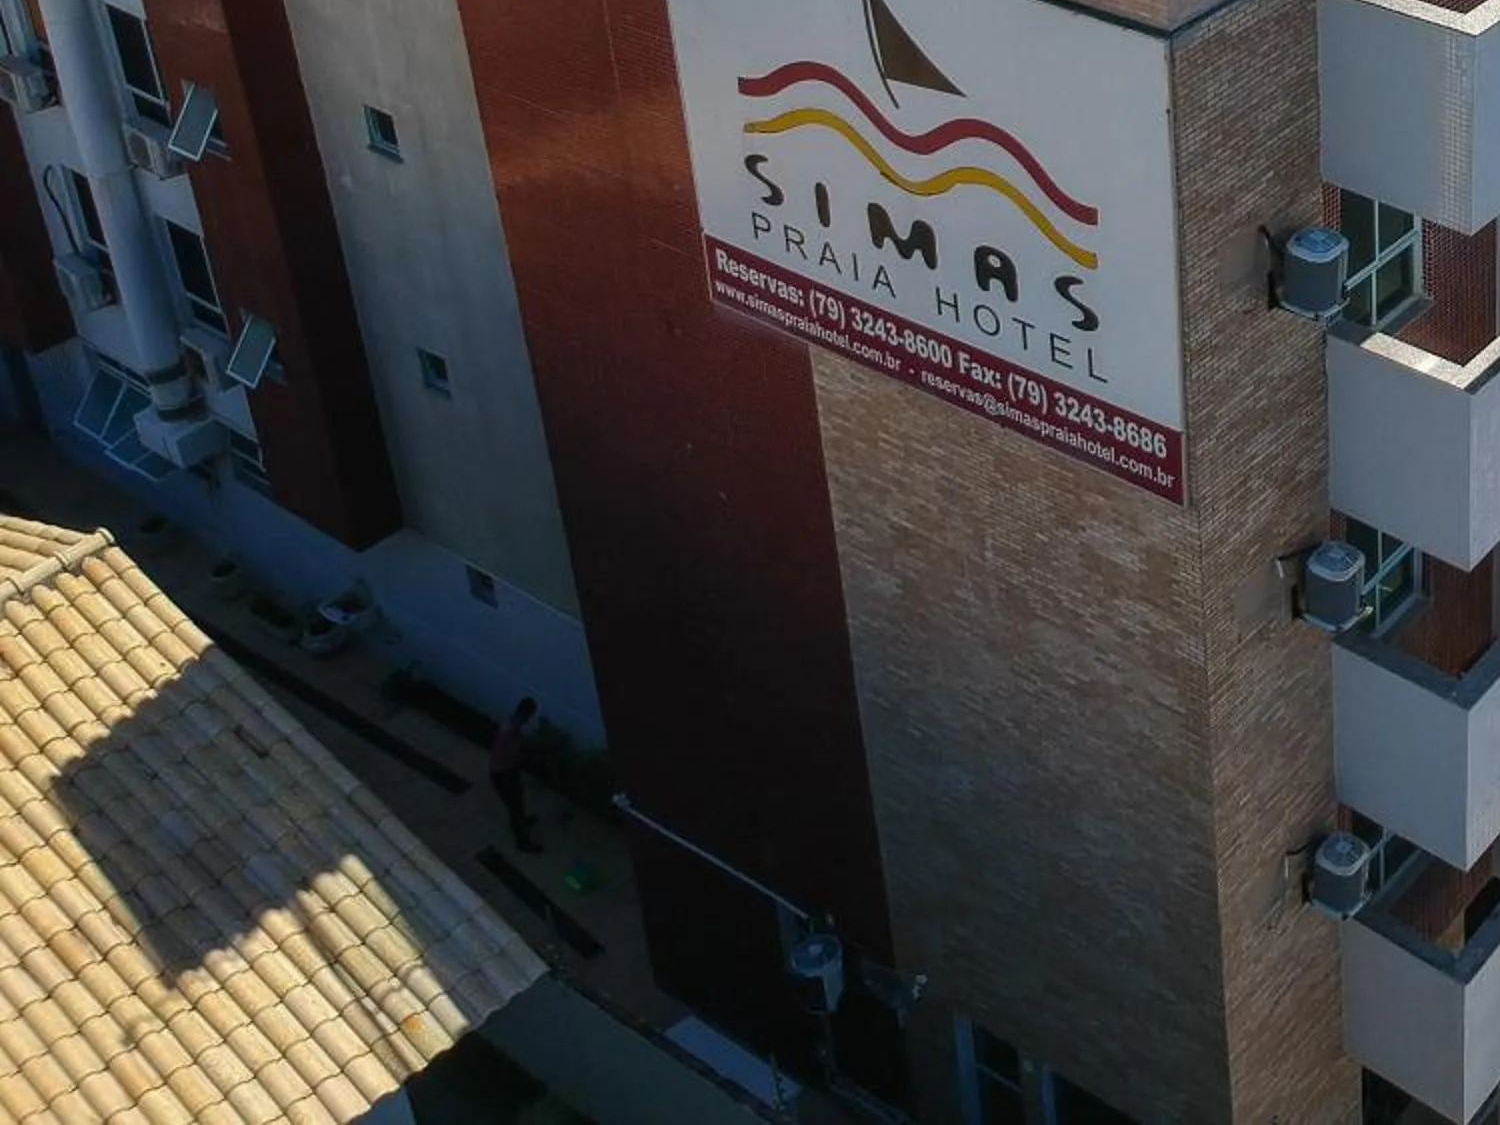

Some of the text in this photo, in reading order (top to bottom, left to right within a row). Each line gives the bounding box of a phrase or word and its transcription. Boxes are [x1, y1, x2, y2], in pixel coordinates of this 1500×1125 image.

[744, 153, 1100, 332] SIMAS
[751, 211, 1109, 384] PRAIA HOTEL
[714, 280, 902, 372] www.simaspraiahotel.com.br
[920, 369, 1175, 489] reservas@simaspraiahotel.com.br
[715, 247, 1167, 459] Reservas: (79) 3243-8600 Fax: (79) 3243-8686
